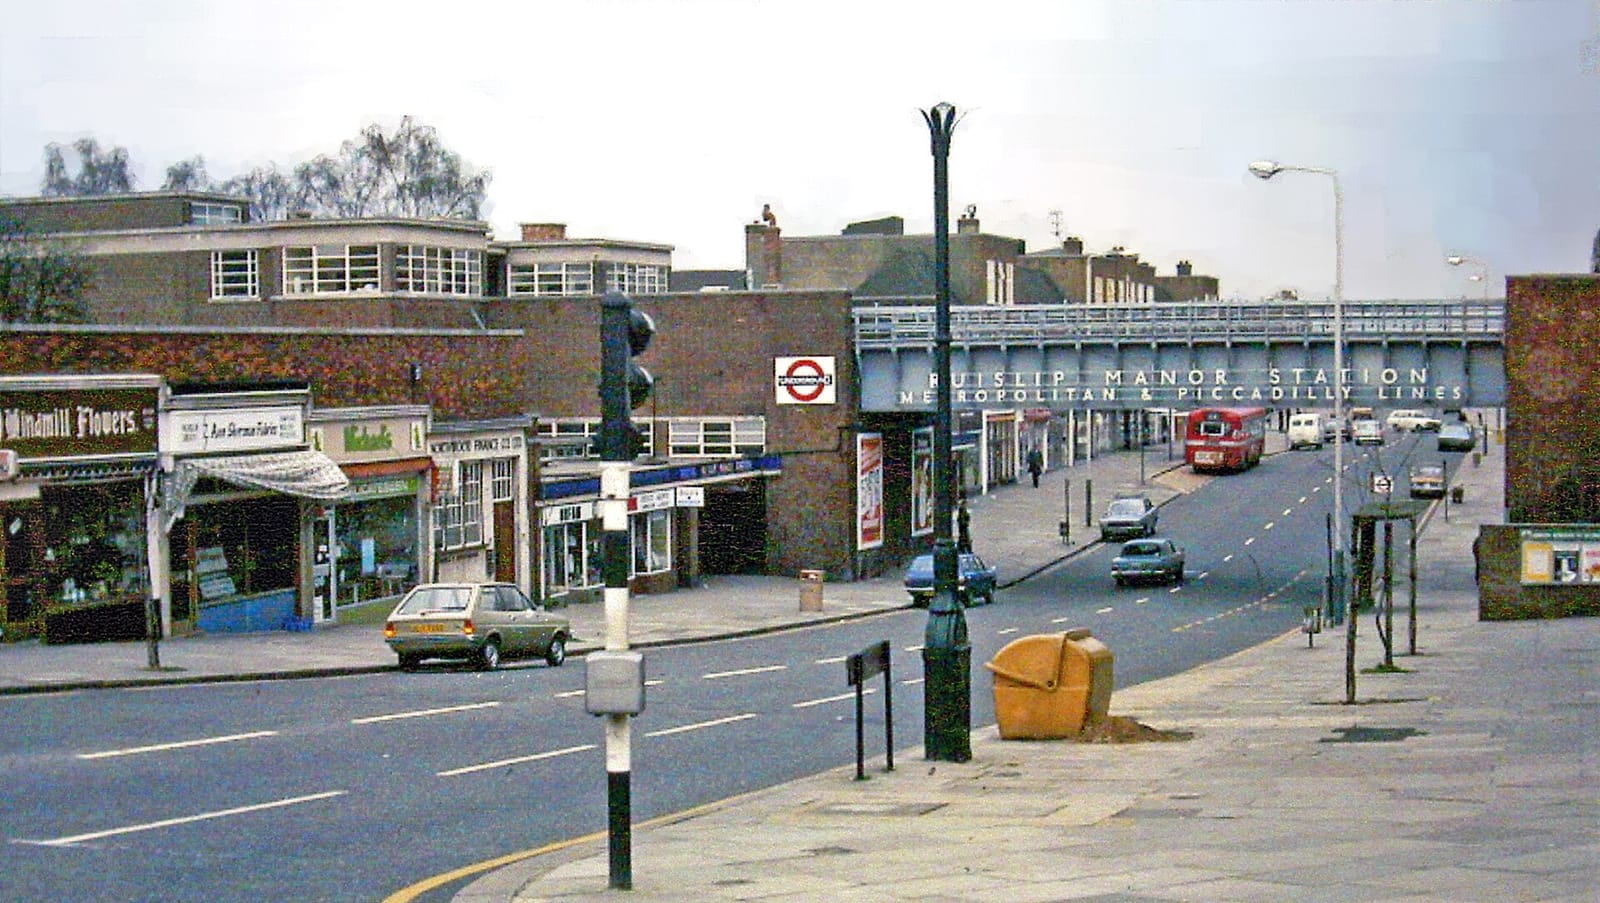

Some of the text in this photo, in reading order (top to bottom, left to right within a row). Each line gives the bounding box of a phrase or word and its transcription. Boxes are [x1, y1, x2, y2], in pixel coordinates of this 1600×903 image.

[929, 368, 1428, 388] RUISLIP MANOR STATION
[901, 386, 1461, 404] MEROPOLITAN & PICCADILLY LINES
[76, 405, 136, 438] Flowers
